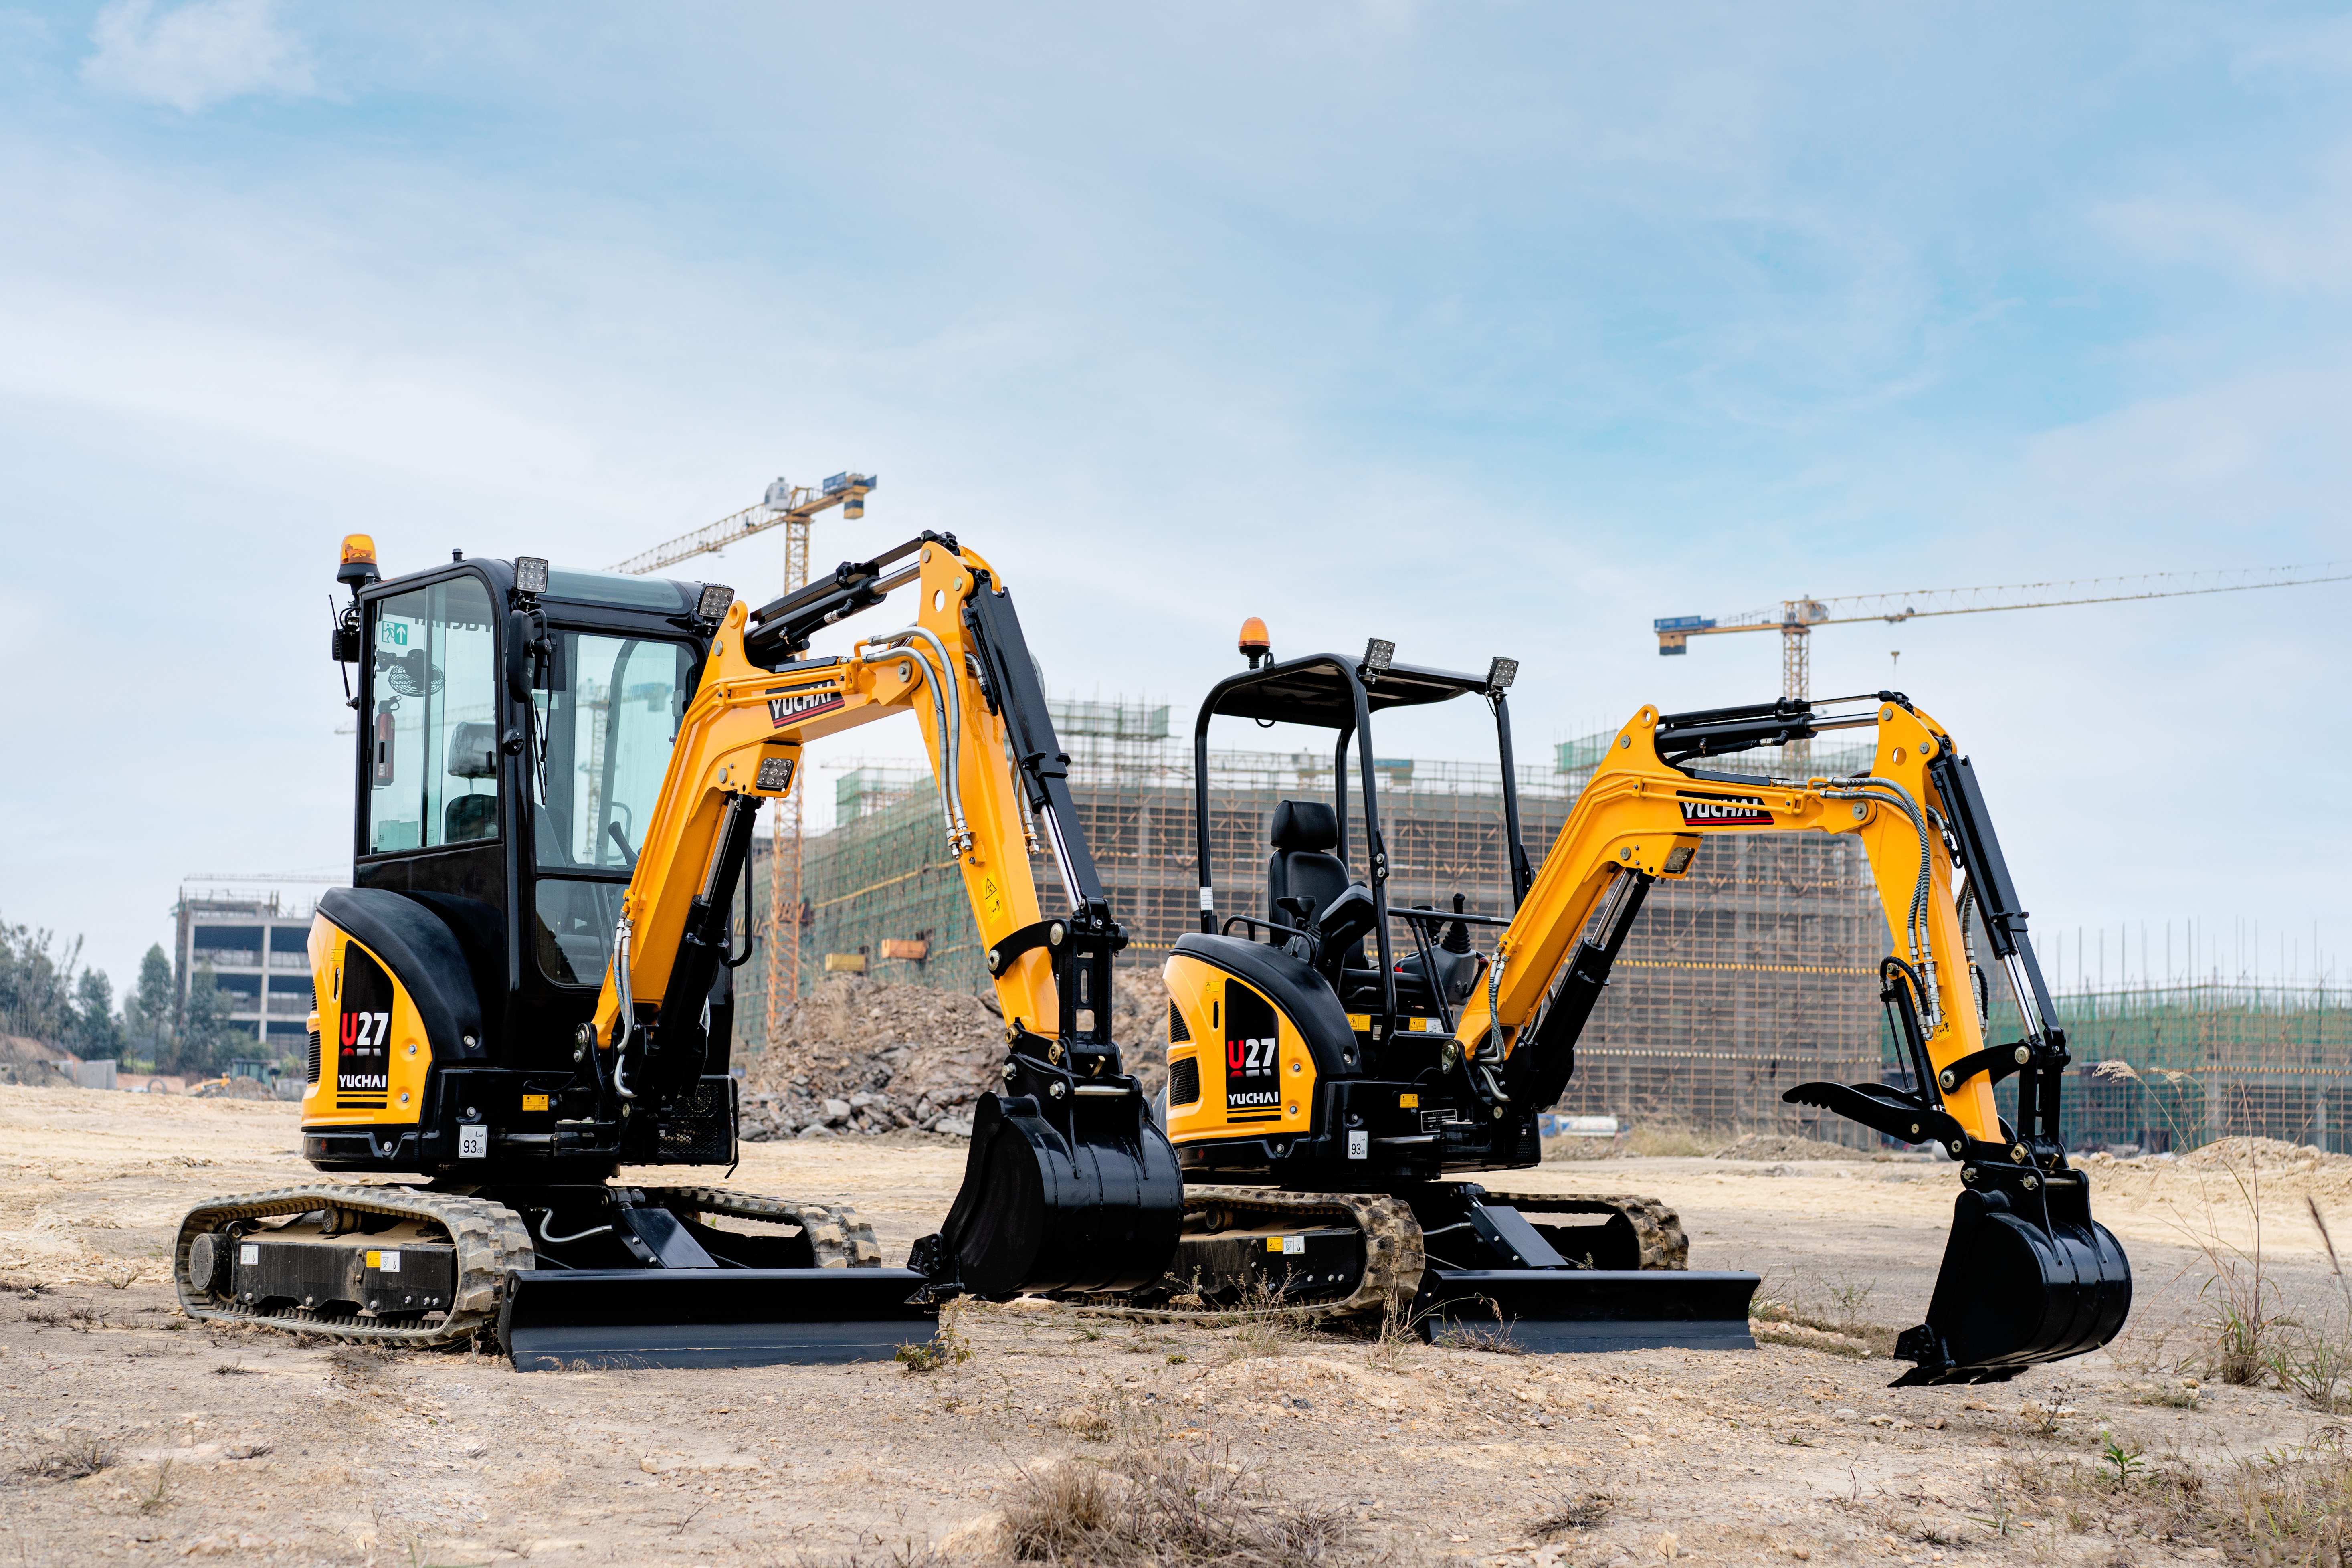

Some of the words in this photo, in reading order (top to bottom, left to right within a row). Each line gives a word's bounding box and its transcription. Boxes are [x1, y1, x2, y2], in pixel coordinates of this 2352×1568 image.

[772, 681, 831, 719] YUCHAI
[1684, 798, 1758, 818] YUCHAI
[342, 1012, 389, 1046] U27
[1228, 1038, 1275, 1069] U27
[339, 1075, 386, 1087] YUCHAI
[1228, 1091, 1278, 1105] YUCHAI
